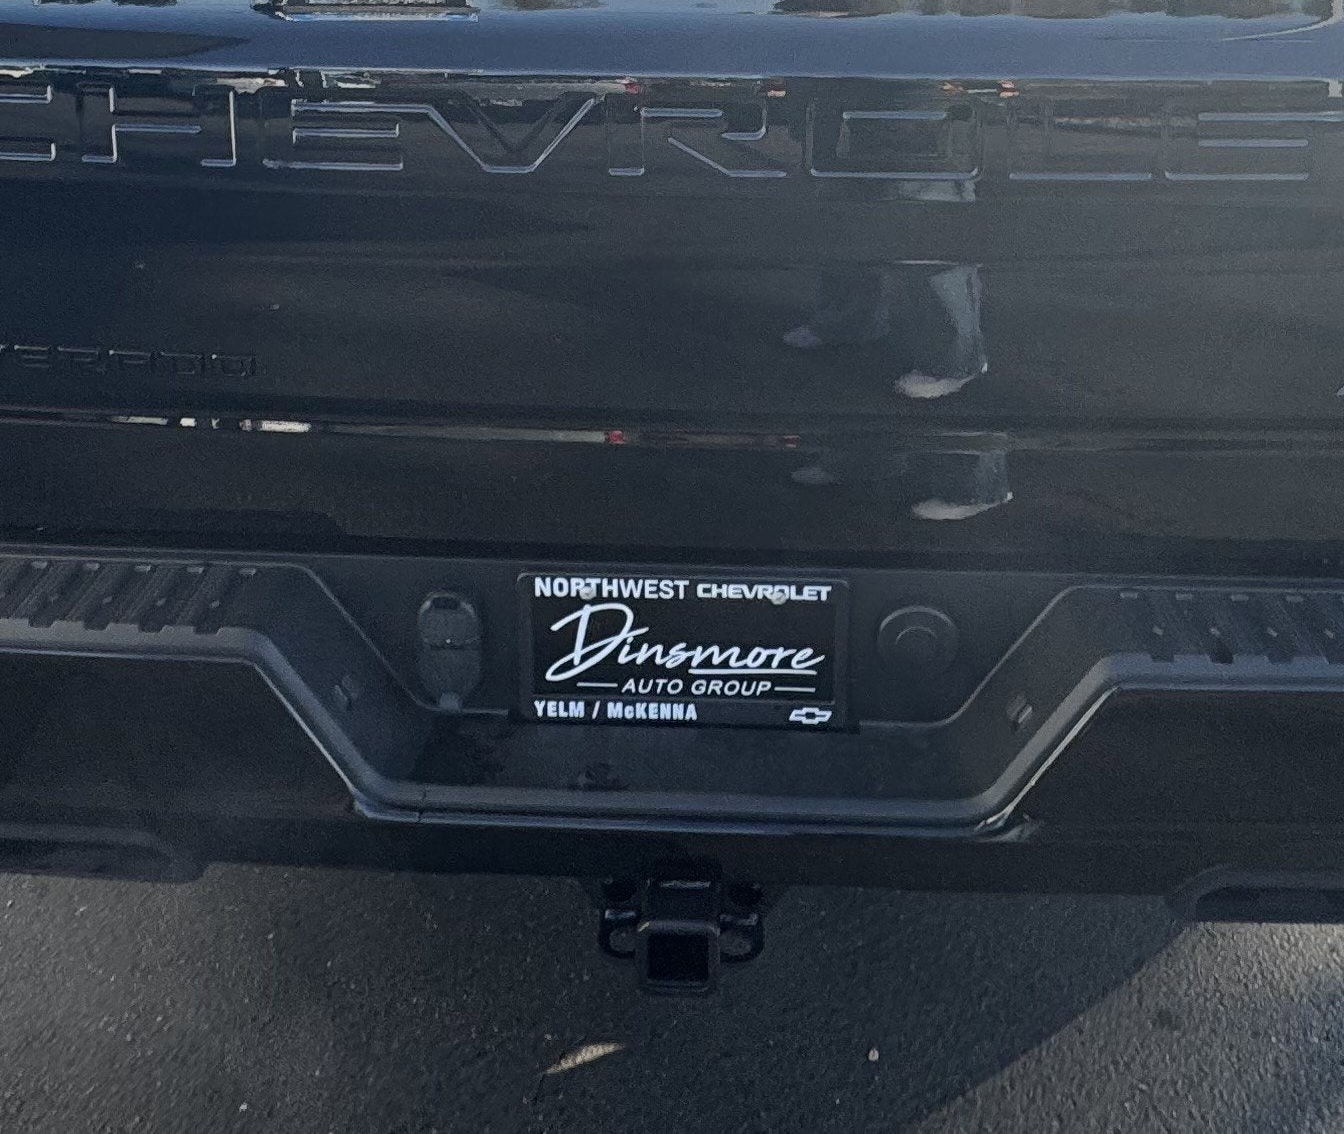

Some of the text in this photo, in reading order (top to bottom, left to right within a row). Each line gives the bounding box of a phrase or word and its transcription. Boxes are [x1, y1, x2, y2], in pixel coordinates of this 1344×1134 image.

[534, 576, 832, 602] NORTHWEST CHEVROLET
[545, 602, 826, 682] Dinsmore
[621, 678, 772, 697] AUTO GROUP
[534, 700, 586, 719] YELM
[607, 702, 698, 721] McKENNA
